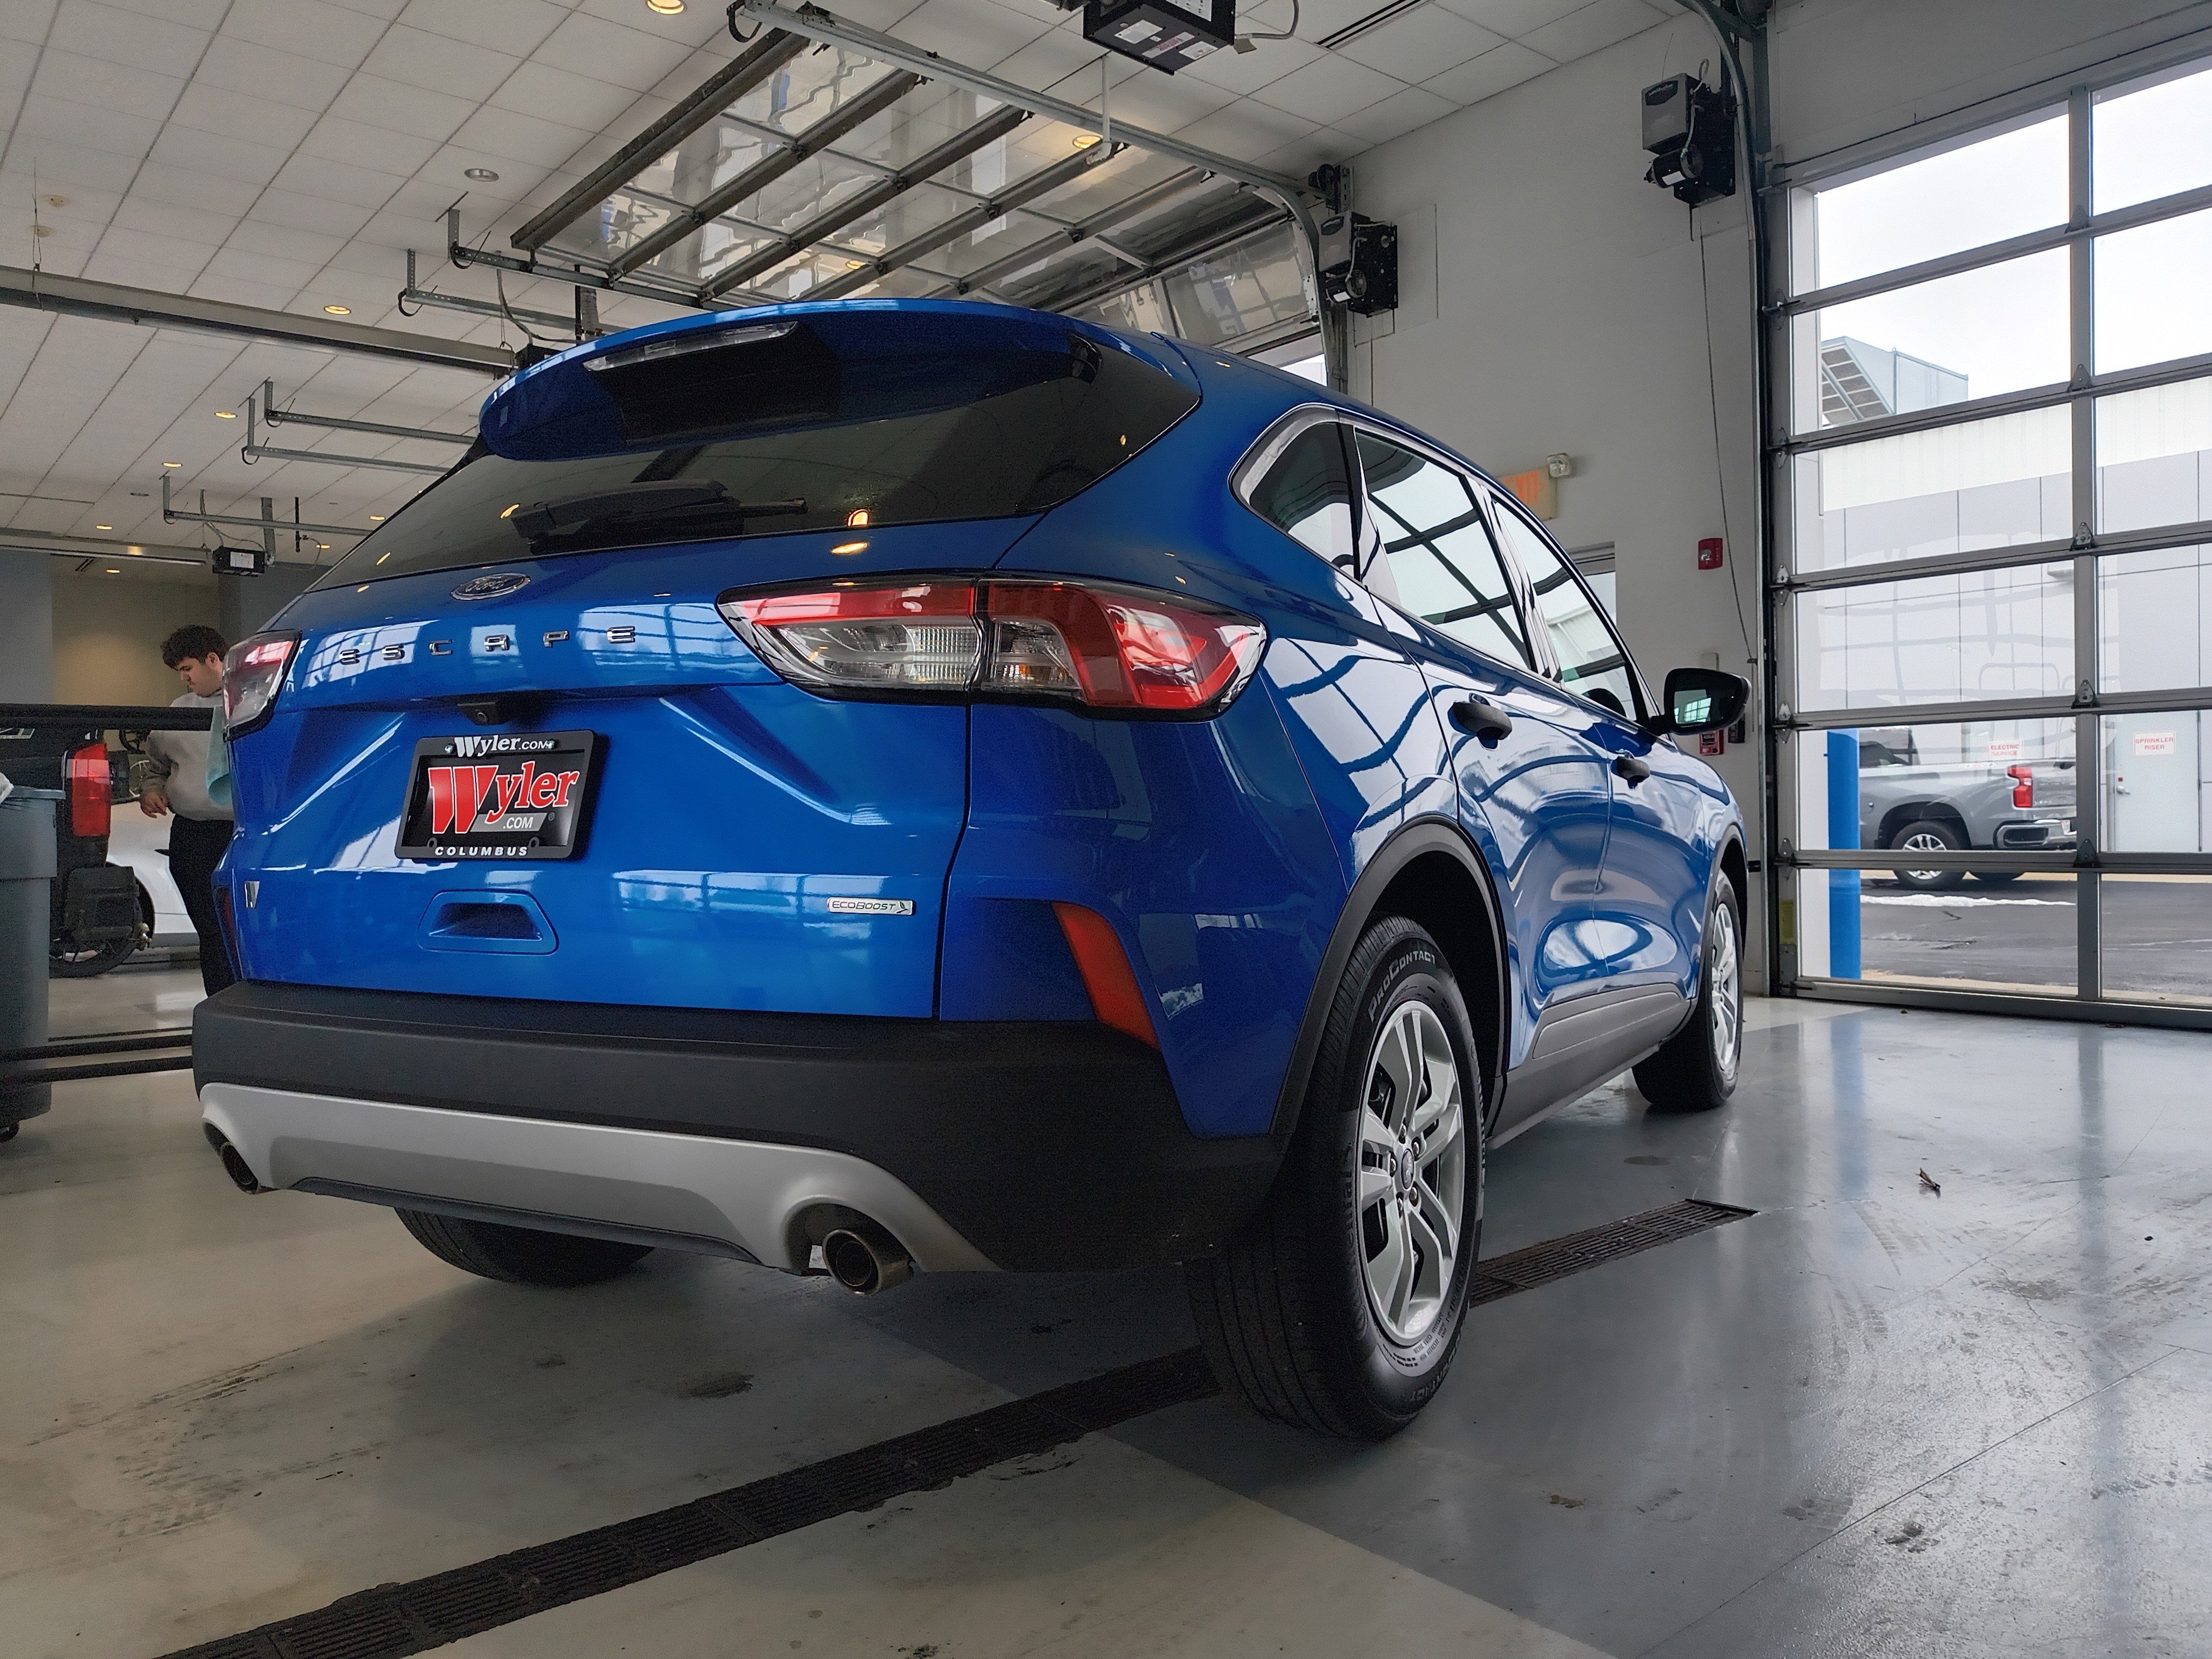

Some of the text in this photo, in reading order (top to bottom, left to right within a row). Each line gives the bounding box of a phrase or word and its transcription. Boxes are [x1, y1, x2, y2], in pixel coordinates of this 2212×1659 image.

[339, 625, 636, 665] ESCAPE
[428, 760, 580, 834] Wyler
[503, 817, 534, 829] .COM
[435, 846, 528, 856] COLUMBUS
